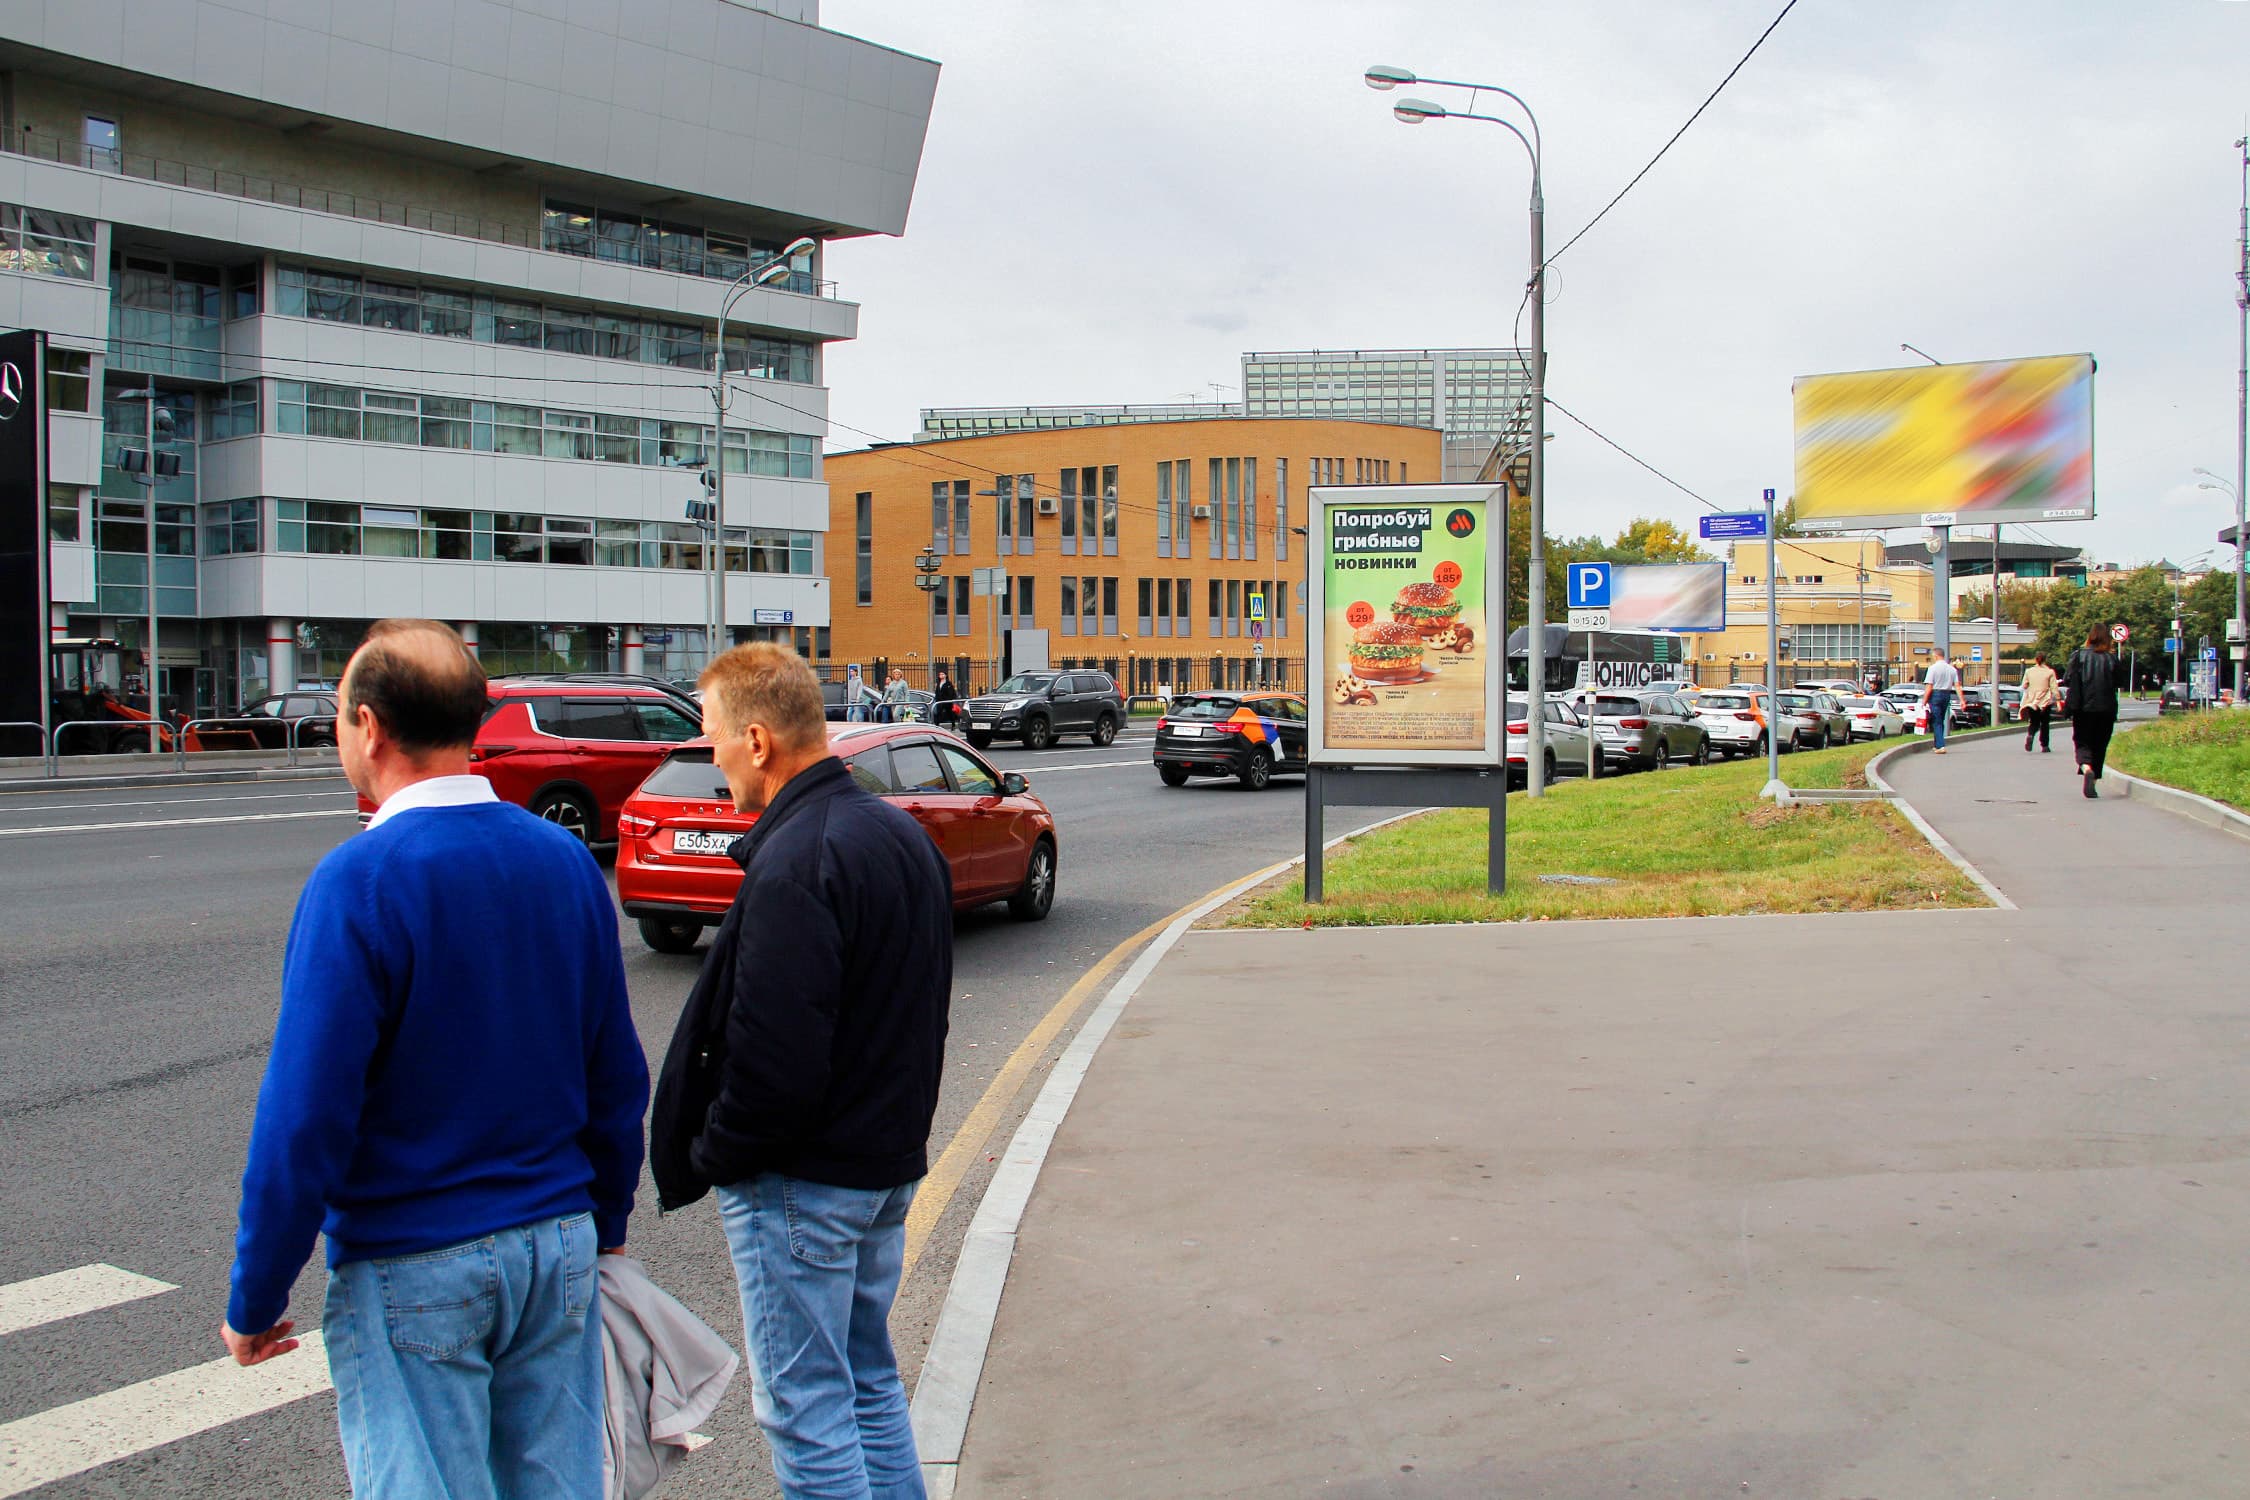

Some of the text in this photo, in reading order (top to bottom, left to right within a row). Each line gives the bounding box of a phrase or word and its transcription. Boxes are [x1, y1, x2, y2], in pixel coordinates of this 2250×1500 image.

[1334, 510, 1430, 528] Попробуй
[1334, 534, 1420, 551] грибные
[1334, 558, 1417, 569] новинки
[1580, 567, 1603, 603] P
[1582, 617, 1590, 625] 15
[1593, 616, 1606, 626] 20
[682, 806, 740, 816] LADA
